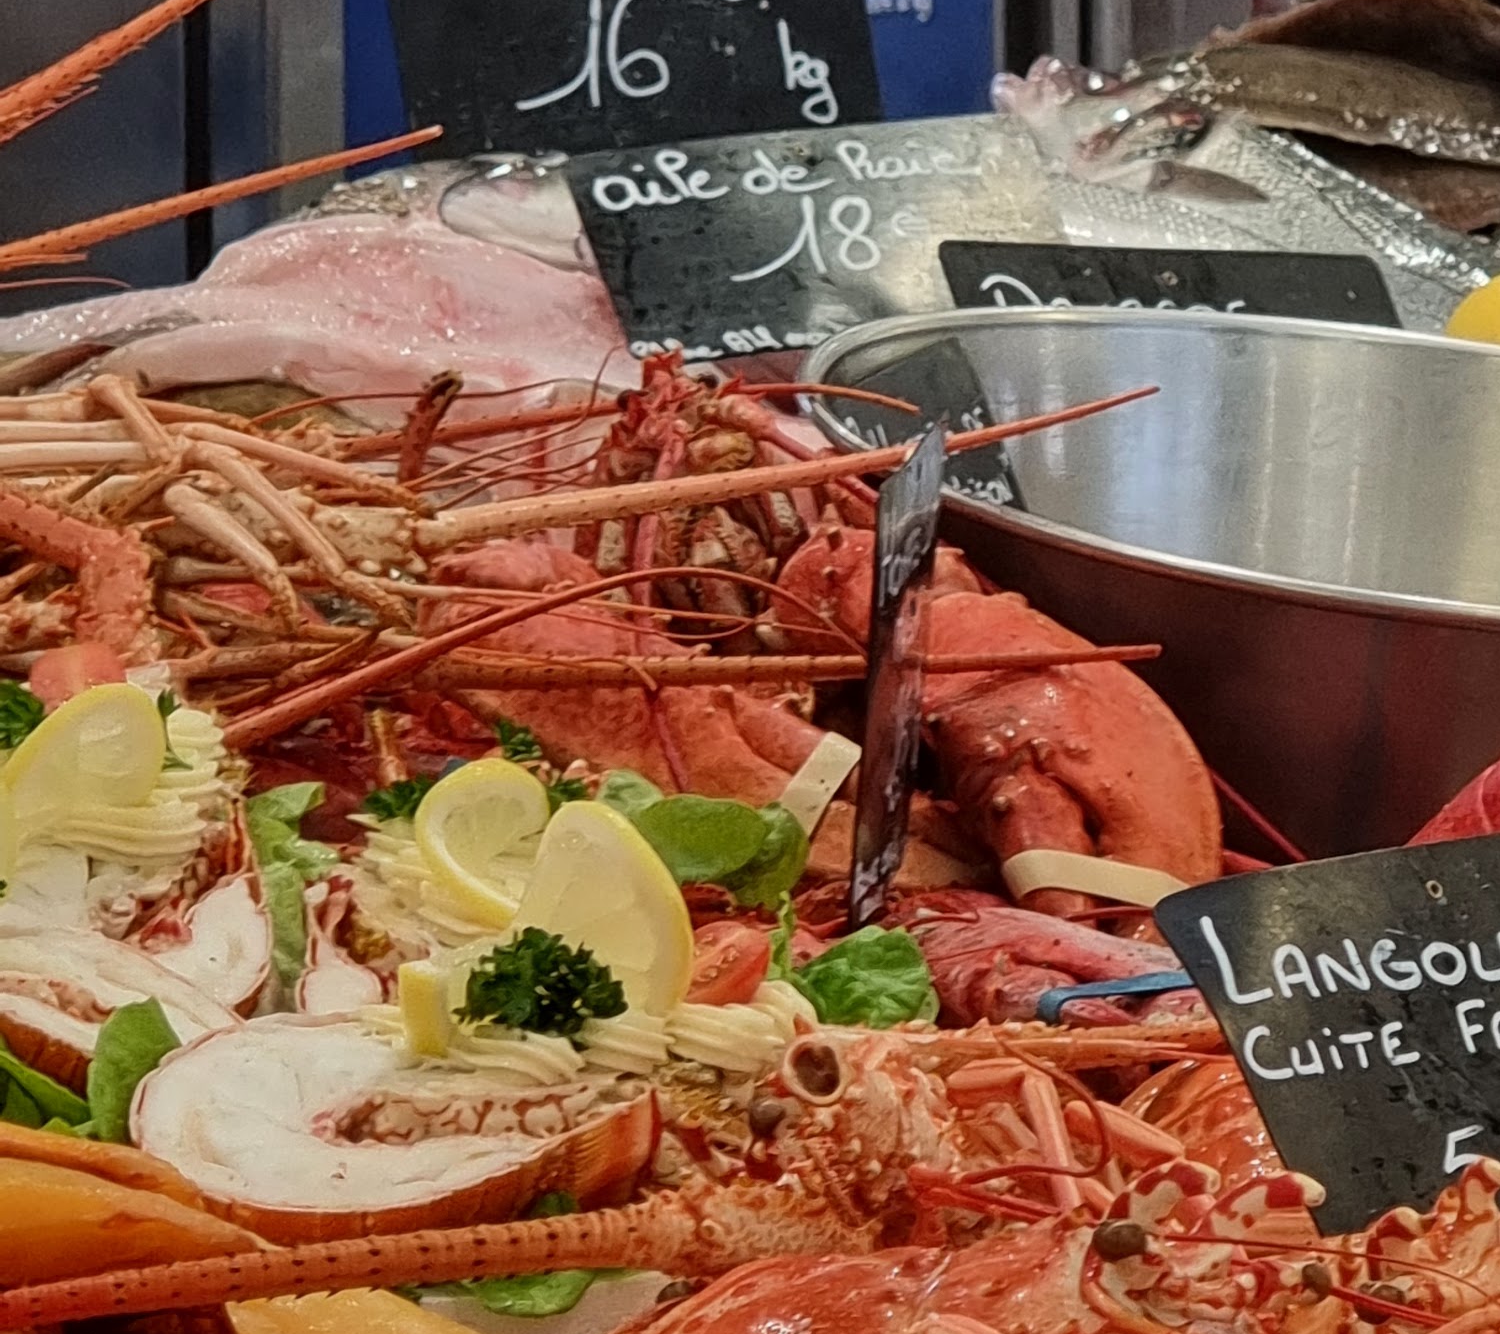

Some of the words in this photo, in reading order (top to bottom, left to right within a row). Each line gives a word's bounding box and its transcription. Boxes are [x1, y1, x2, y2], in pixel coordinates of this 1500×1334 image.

[777, 17, 839, 125] kg
[742, 149, 837, 194] de
[729, 194, 882, 283] 18
